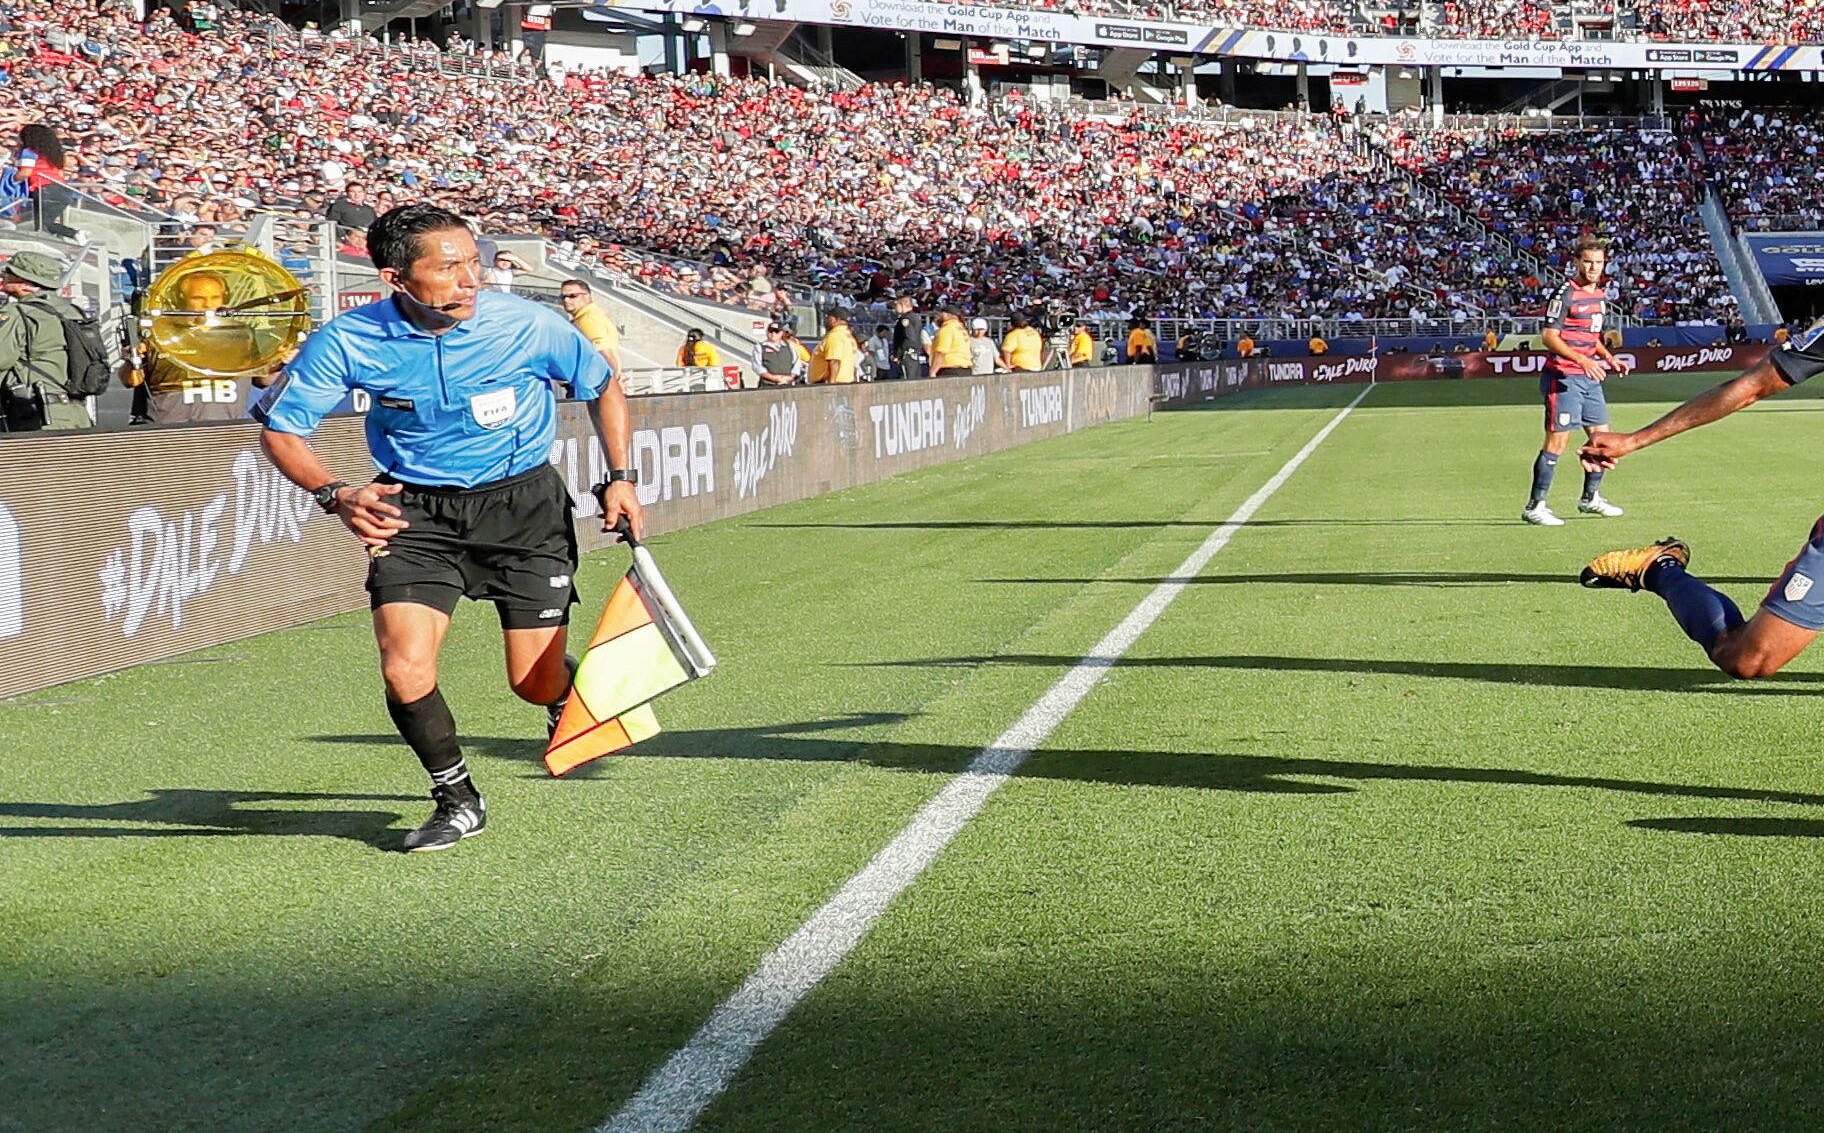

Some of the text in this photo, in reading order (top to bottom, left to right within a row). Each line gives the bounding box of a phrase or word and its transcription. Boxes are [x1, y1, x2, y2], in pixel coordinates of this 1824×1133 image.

[860, 11, 1062, 40] Vote for the Man of the Match
[927, 2, 945, 16] the
[947, 4, 976, 18] Gold
[979, 7, 1003, 23] Cup
[1005, 9, 1030, 25] App
[1032, 13, 1052, 25] and
[1268, 362, 1304, 381] TUNDRA
[1345, 356, 1378, 374] DURO
[1698, 347, 1733, 366] DURO
[181, 379, 238, 405] HB
[483, 405, 509, 417] FIFA
[1019, 385, 1063, 427] TUNDRA
[869, 397, 945, 458] TUNDRA
[970, 384, 986, 433] DURO
[768, 401, 797, 471] DURO
